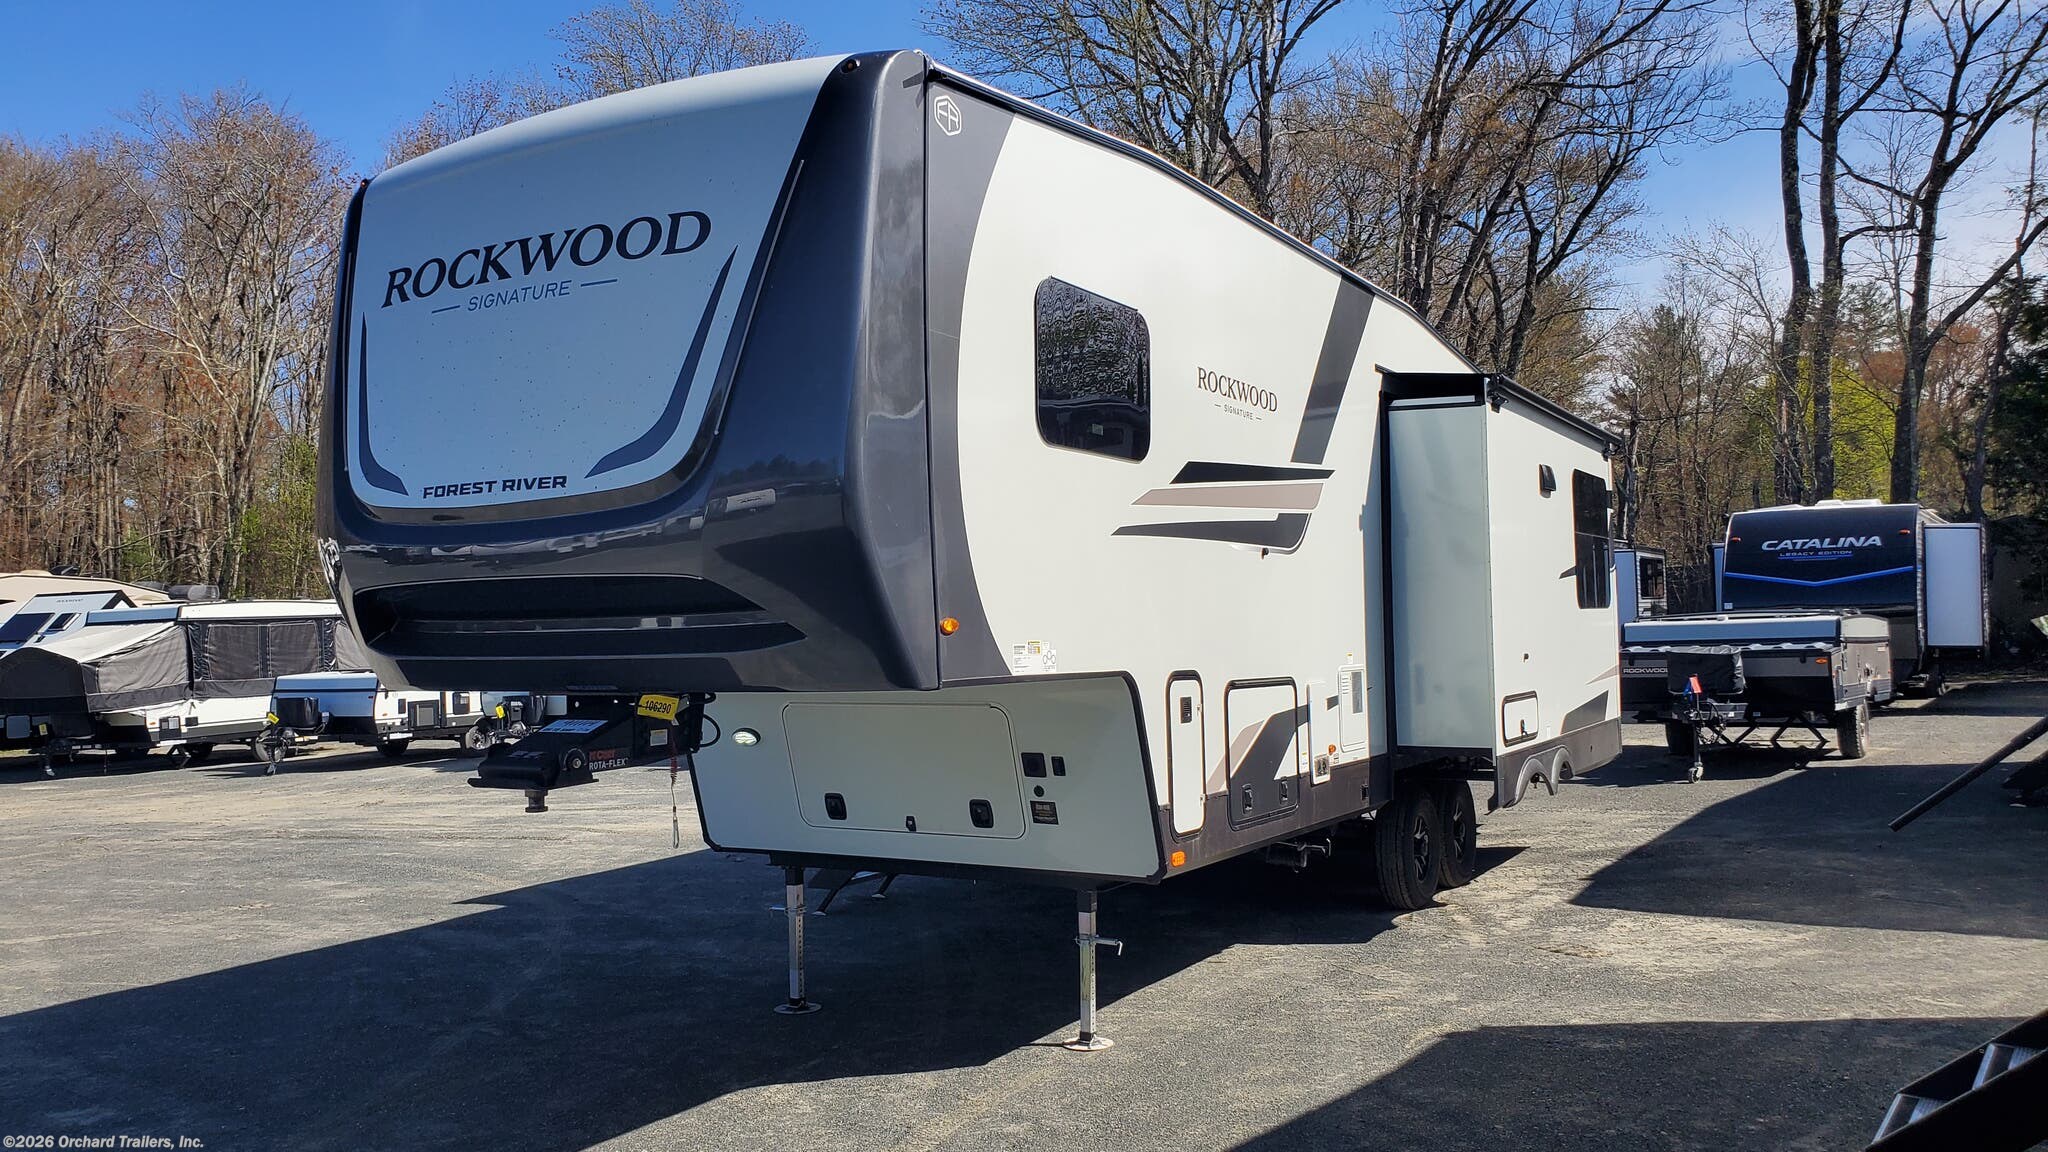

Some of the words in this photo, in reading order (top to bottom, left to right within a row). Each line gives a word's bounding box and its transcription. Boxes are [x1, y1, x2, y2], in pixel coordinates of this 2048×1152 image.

[381, 210, 712, 308] ROCKWOOD
[467, 280, 573, 312] SIGNATURE
[1196, 366, 1278, 412] ROCKWOOD
[1223, 404, 1254, 421] SIGNATURE
[422, 480, 498, 499] FOREST
[502, 475, 567, 493] RIVER
[1761, 535, 1883, 551] CATALINA
